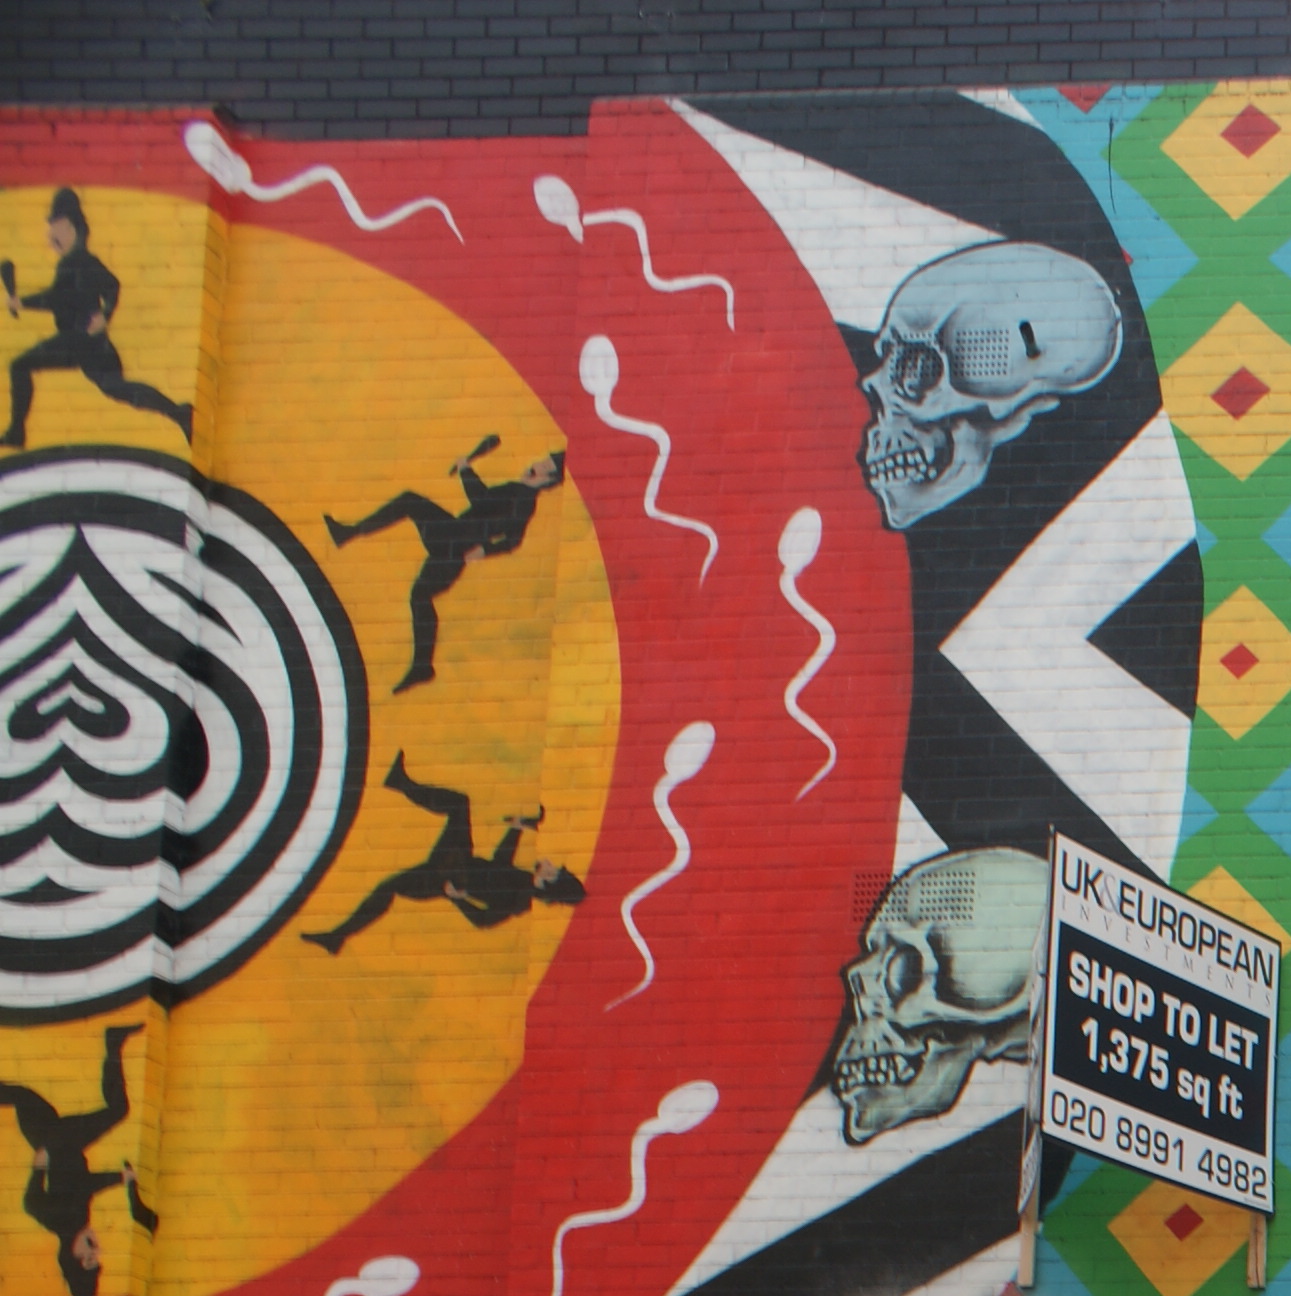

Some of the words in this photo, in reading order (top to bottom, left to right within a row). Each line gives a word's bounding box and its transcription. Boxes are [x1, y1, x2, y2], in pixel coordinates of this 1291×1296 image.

[1062, 894, 1272, 1007] INVESTMENTS
[1068, 950, 1155, 1024] SHOP
[1163, 992, 1201, 1047] TO
[1207, 1013, 1260, 1072] LET
[1081, 1017, 1170, 1091] 1,375
[1176, 1066, 1211, 1119] sq
[1218, 1074, 1244, 1122] ft
[1051, 1091, 1106, 1142] 020
[1115, 1117, 1185, 1173] 8991
[1197, 1149, 1268, 1200] 4982
